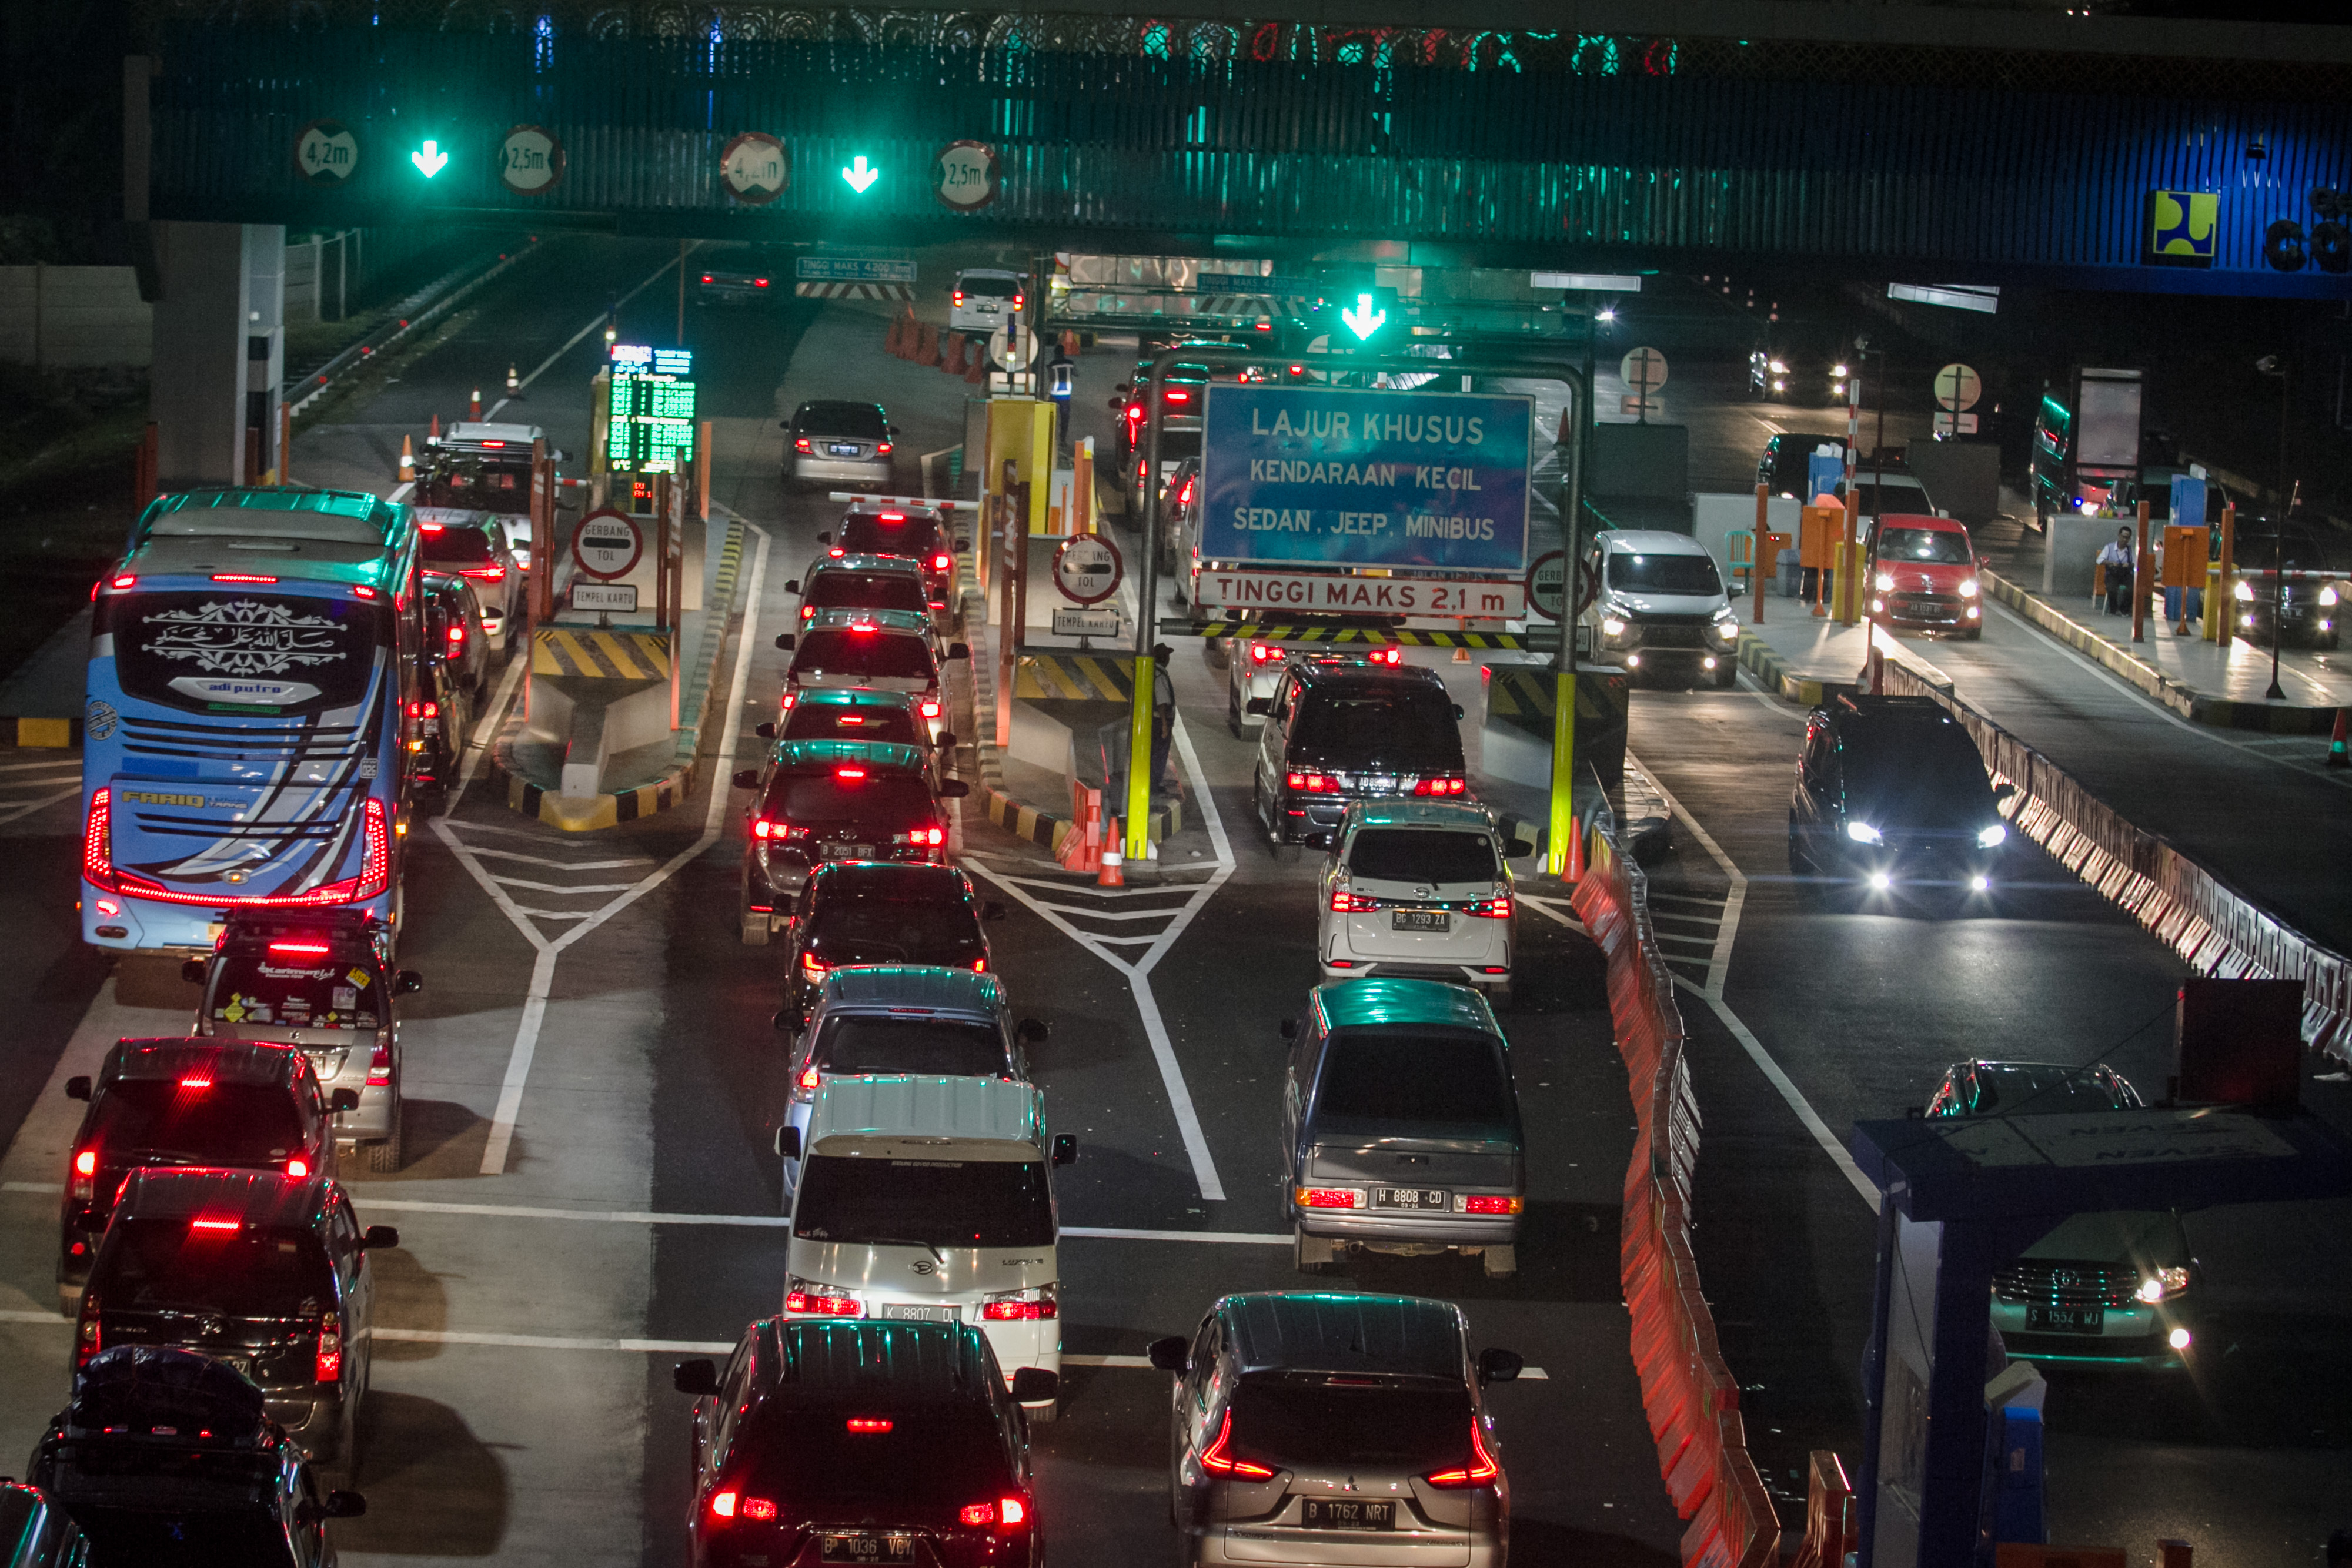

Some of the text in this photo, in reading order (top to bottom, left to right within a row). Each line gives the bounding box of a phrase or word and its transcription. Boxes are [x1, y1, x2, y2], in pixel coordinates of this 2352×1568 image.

[307, 142, 349, 167] 4,2m
[512, 148, 544, 172] 2,5m
[948, 163, 981, 188] 2,5m
[803, 260, 830, 269] TINGGI
[834, 262, 858, 270] MAKS
[1252, 408, 1484, 445] LAJUR KHUSUS
[1250, 459, 1482, 491] KENDARAAN KECIL
[585, 524, 630, 536] GERBANG
[1406, 516, 1495, 540] MINIBUS
[597, 550, 614, 561] TOL
[1078, 576, 1095, 587] TOL
[576, 591, 634, 604] TEMPEL KARTU
[1217, 578, 1505, 611] TINGGI MAKS 2,1 m
[1551, 596, 1563, 607] TO
[1057, 617, 1085, 628] TEMPEL
[122, 791, 205, 808] FARIQ
[823, 845, 828, 855] B
[834, 846, 852, 856] 2051
[1396, 913, 1445, 925] BG 1293 ZA
[1379, 1189, 1442, 1204] H 8808 CD
[886, 1306, 894, 1319] K
[903, 1307, 931, 1321] 8807
[2030, 1309, 2099, 1326] S 1554 WJ
[1308, 1503, 1390, 1521] B 1762 NRT
[824, 1538, 832, 1554] B
[847, 1538, 877, 1554] 1036
